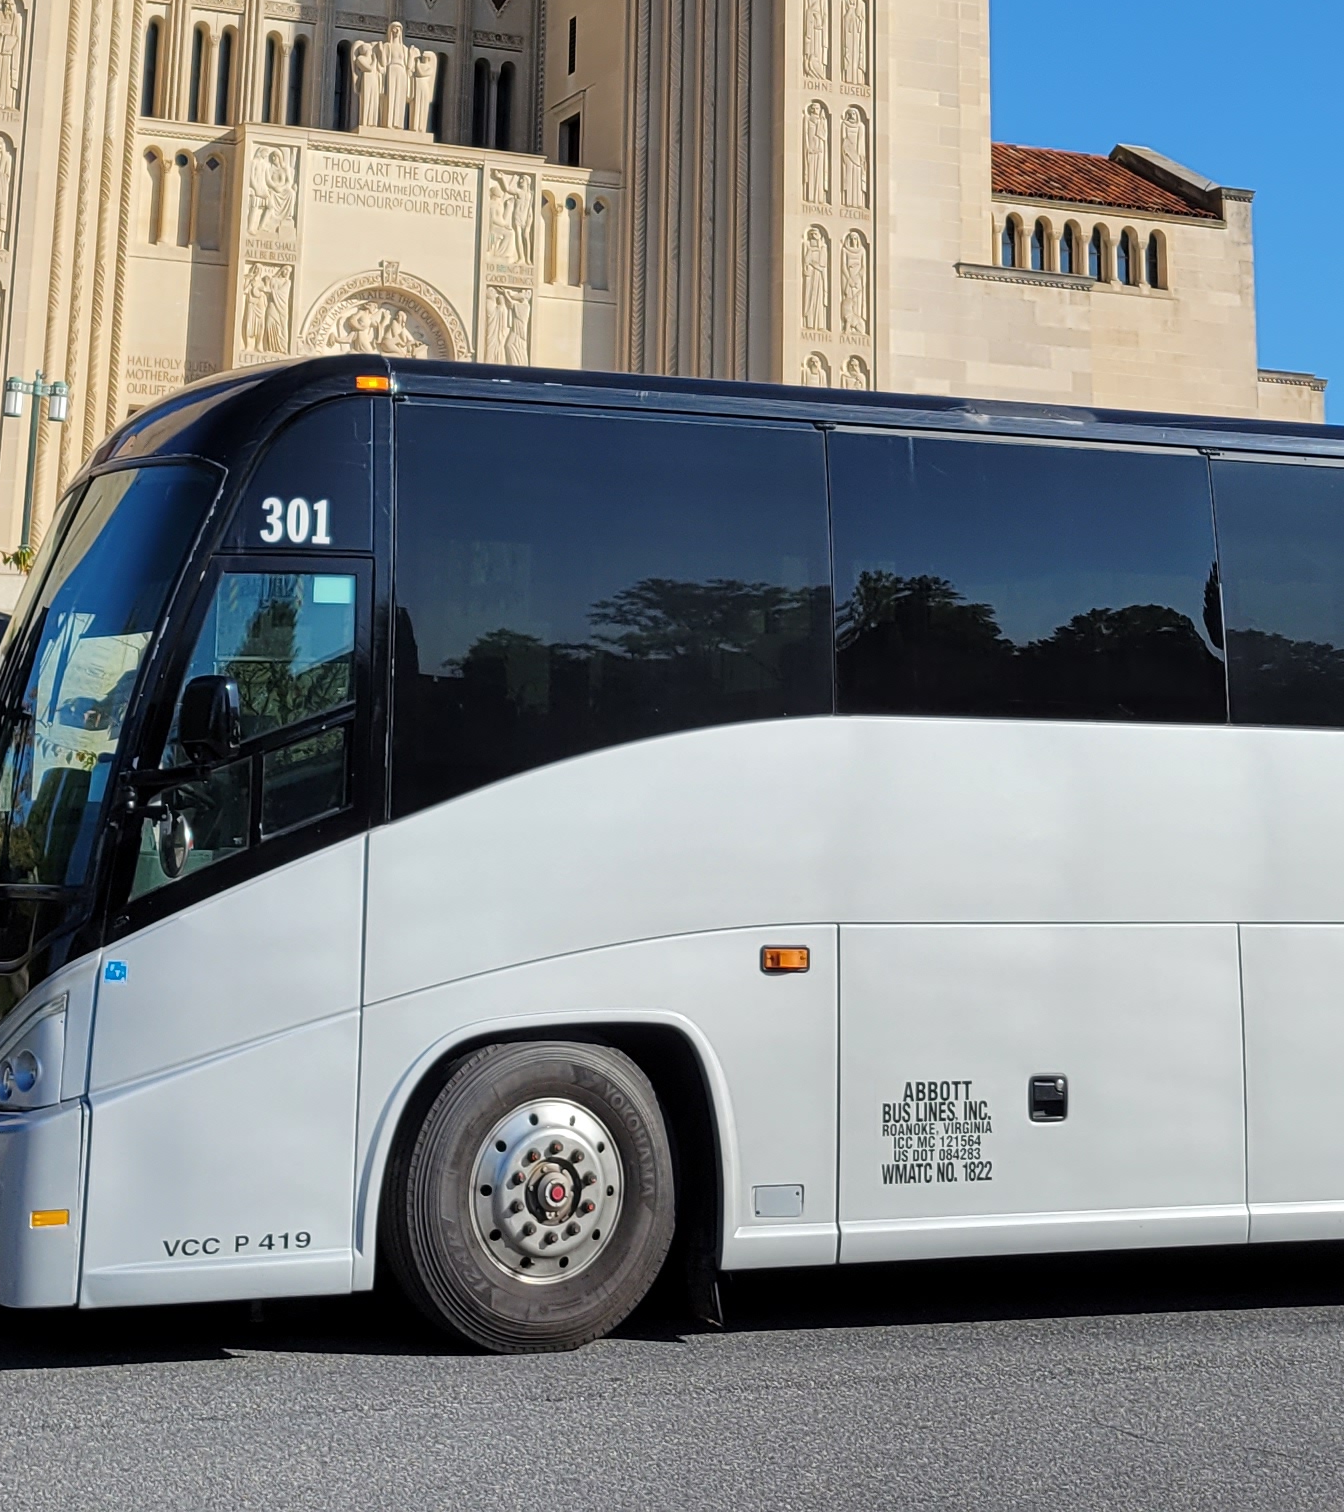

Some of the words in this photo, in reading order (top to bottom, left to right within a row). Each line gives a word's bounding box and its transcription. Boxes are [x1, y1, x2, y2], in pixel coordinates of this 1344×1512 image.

[803, 80, 828, 92] JOHN
[323, 156, 360, 173] THOU
[366, 162, 391, 177] ART
[396, 165, 419, 180] THE
[424, 169, 468, 186] GLORY
[313, 173, 329, 186] OF
[331, 175, 392, 194] JERUSALEM
[393, 185, 407, 196] THE
[408, 184, 428, 198] JOY
[428, 189, 439, 199] OF
[441, 188, 473, 203] ISRAEL
[313, 189, 334, 203] THE
[337, 192, 392, 210] HONOUR
[392, 198, 403, 208] OF
[405, 199, 431, 215] OUR
[433, 202, 473, 219] PEOPLE
[246, 239, 254, 248] IN
[399, 295, 421, 313] THOU
[421, 311, 436, 330] OUR
[127, 355, 153, 369] HAIL
[154, 357, 181, 370] HOLY
[184, 359, 217, 372] QUEEN
[126, 369, 170, 382] MOTHER
[127, 382, 148, 395] OUR
[149, 384, 167, 396] LIFE
[260, 497, 331, 545] 301
[903, 1080, 972, 1102] ABBOTT
[882, 1102, 911, 1124] BUS
[963, 1100, 992, 1122] INC.
[605, 1082, 654, 1197] YOKOHAMA
[882, 1122, 939, 1137] ROANOKE,
[943, 1121, 992, 1135] VIRGINIA
[893, 1136, 913, 1150] ICC
[917, 1135, 936, 1149] MC
[940, 1134, 981, 1148] 121564
[893, 1149, 909, 1163] US
[913, 1148, 936, 1162] DOT
[939, 1147, 981, 1161] 084283
[882, 1162, 933, 1185] WMATC
[937, 1161, 957, 1183] NO.
[962, 1160, 993, 1182] 1822
[162, 1238, 221, 1257] VCC
[235, 1235, 250, 1253] P
[258, 1231, 312, 1251] 419
